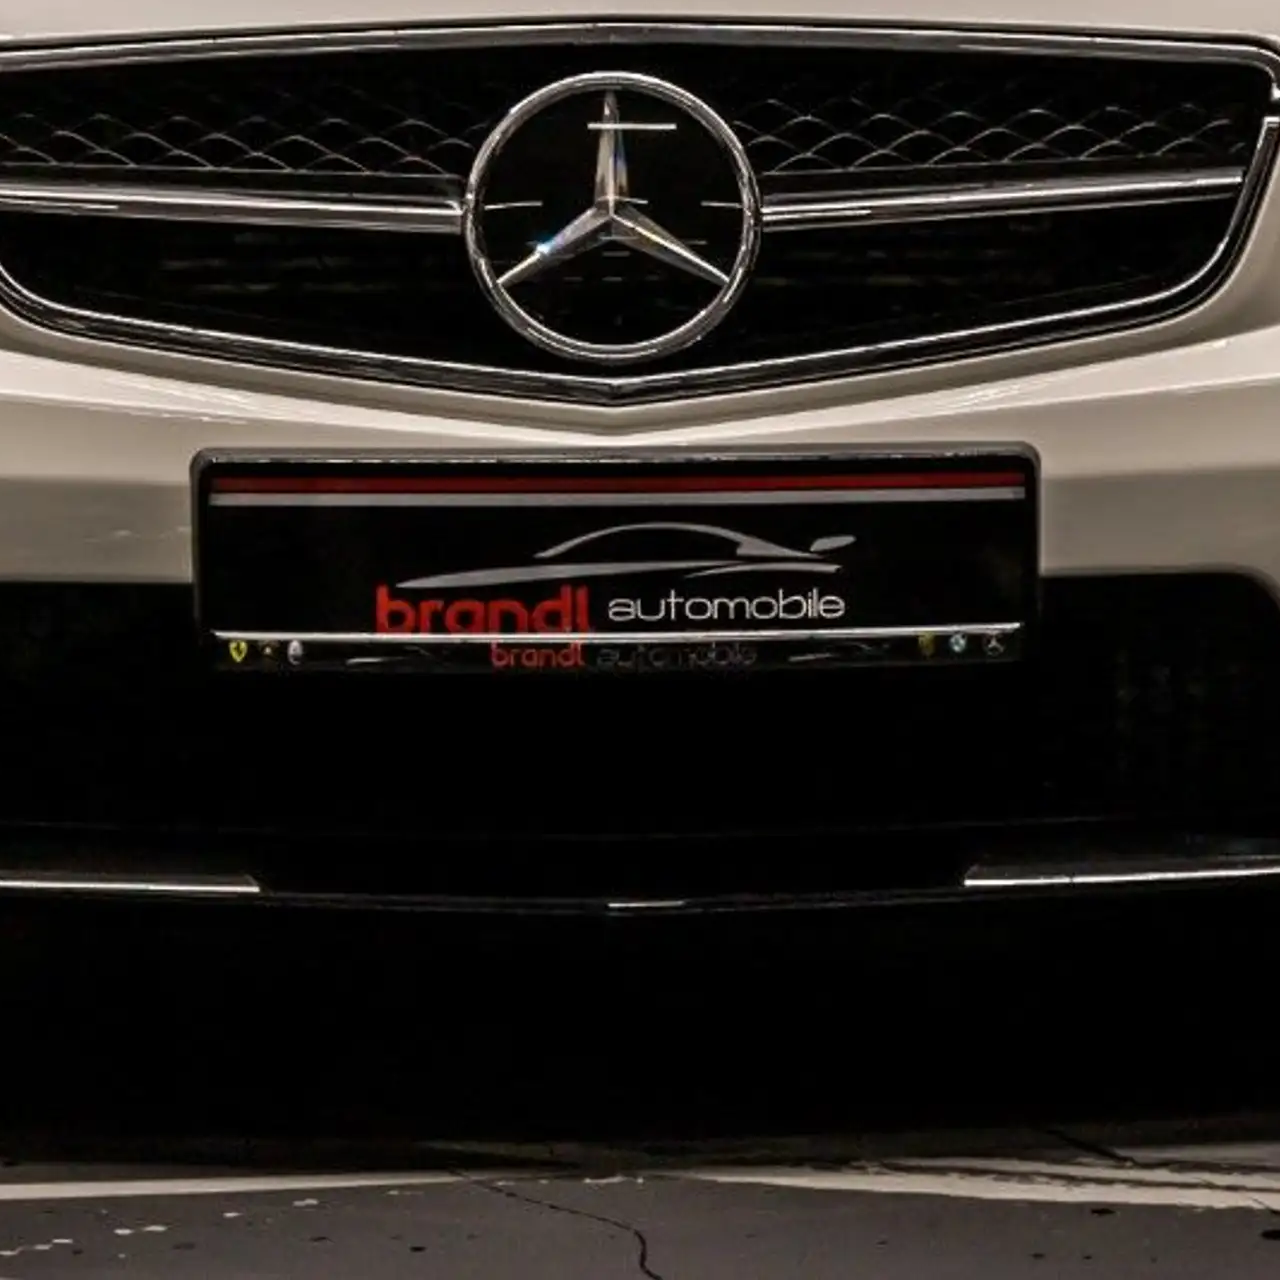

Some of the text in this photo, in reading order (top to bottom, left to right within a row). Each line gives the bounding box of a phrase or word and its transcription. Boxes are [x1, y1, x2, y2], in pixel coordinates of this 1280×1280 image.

[375, 584, 846, 634] brandl automobile
[491, 642, 586, 669] brandl
